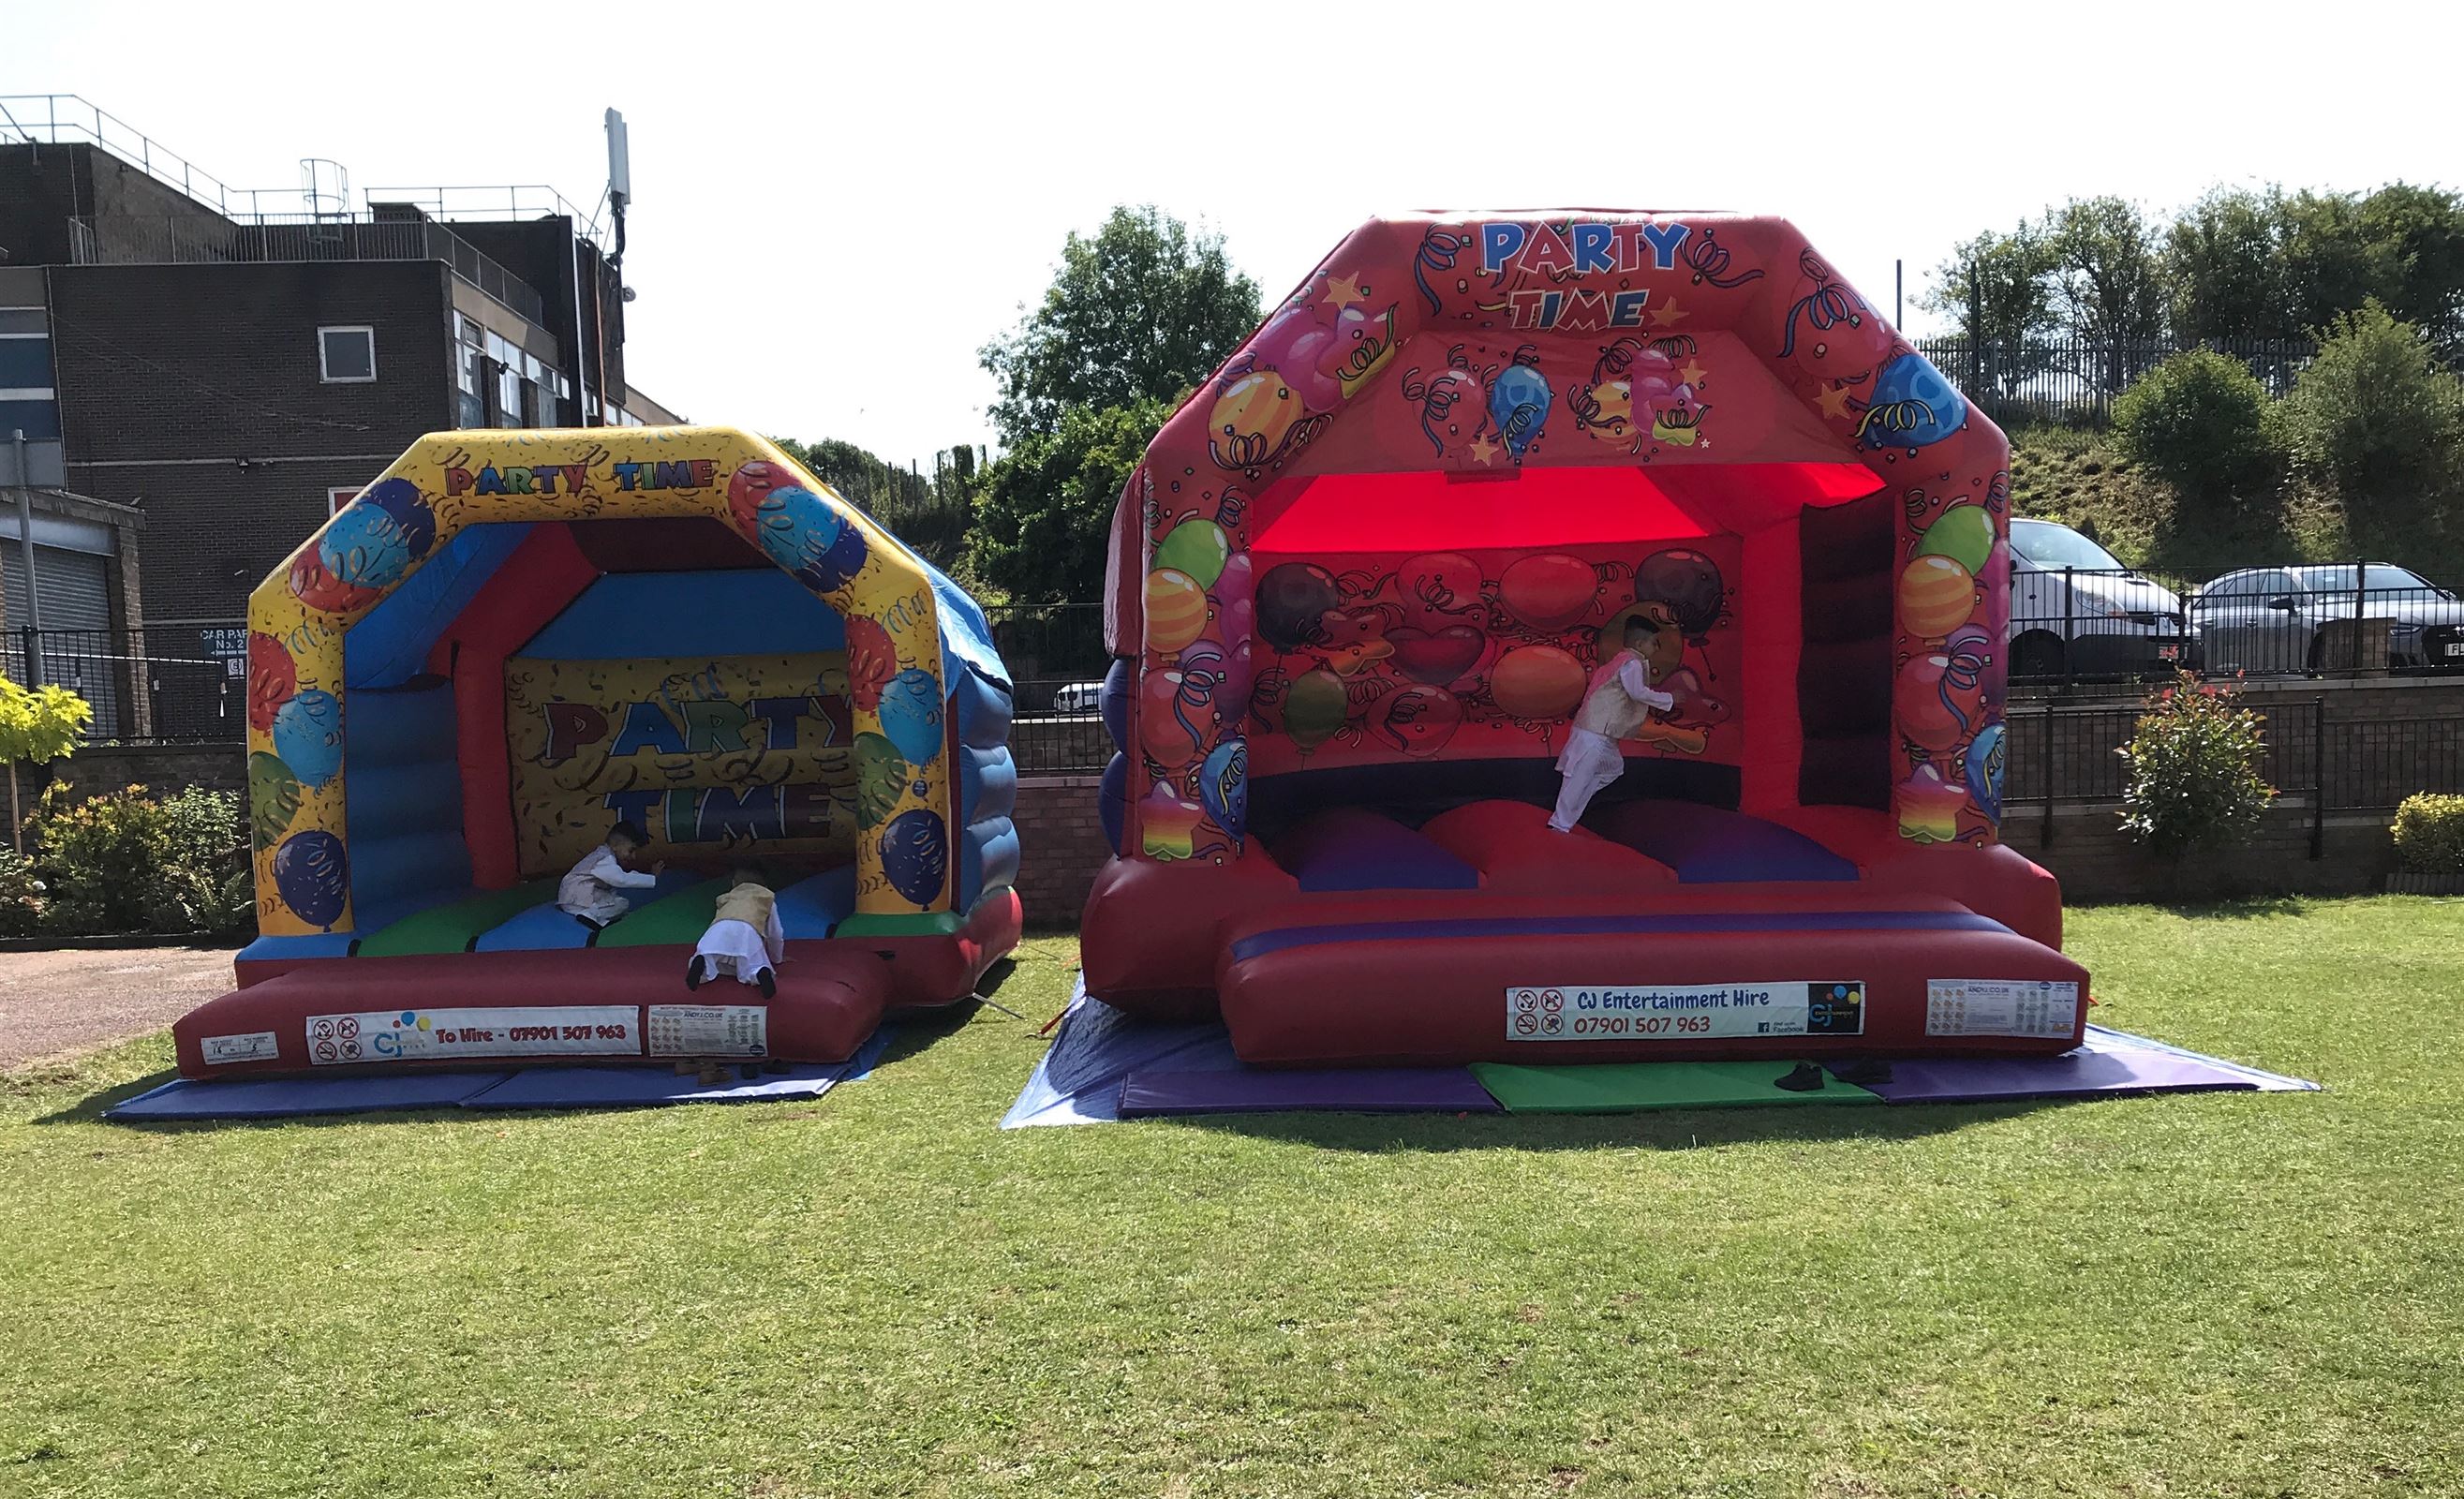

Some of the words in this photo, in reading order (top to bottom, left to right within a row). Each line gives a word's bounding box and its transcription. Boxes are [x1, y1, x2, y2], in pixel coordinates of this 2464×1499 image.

[1481, 221, 1690, 275] PARTY
[1509, 287, 1650, 331] TIME
[444, 464, 587, 496] PARTY
[613, 459, 714, 491] TIME
[200, 630, 225, 639] CAR
[215, 639, 234, 649] No.
[237, 639, 244, 648] 2
[602, 782, 831, 844] TIME
[1578, 991, 1597, 1010] CJ
[1603, 989, 1729, 1010] Entertainment
[1733, 989, 1770, 1007] Hire
[436, 1028, 456, 1044] To
[459, 1027, 494, 1043] Hire
[509, 1025, 558, 1041] 07901
[562, 1024, 593, 1041] 507
[596, 1024, 627, 1040] 963
[1574, 1017, 1629, 1034] 07901
[1635, 1017, 1671, 1033] 507
[1677, 1016, 1711, 1032] 963
